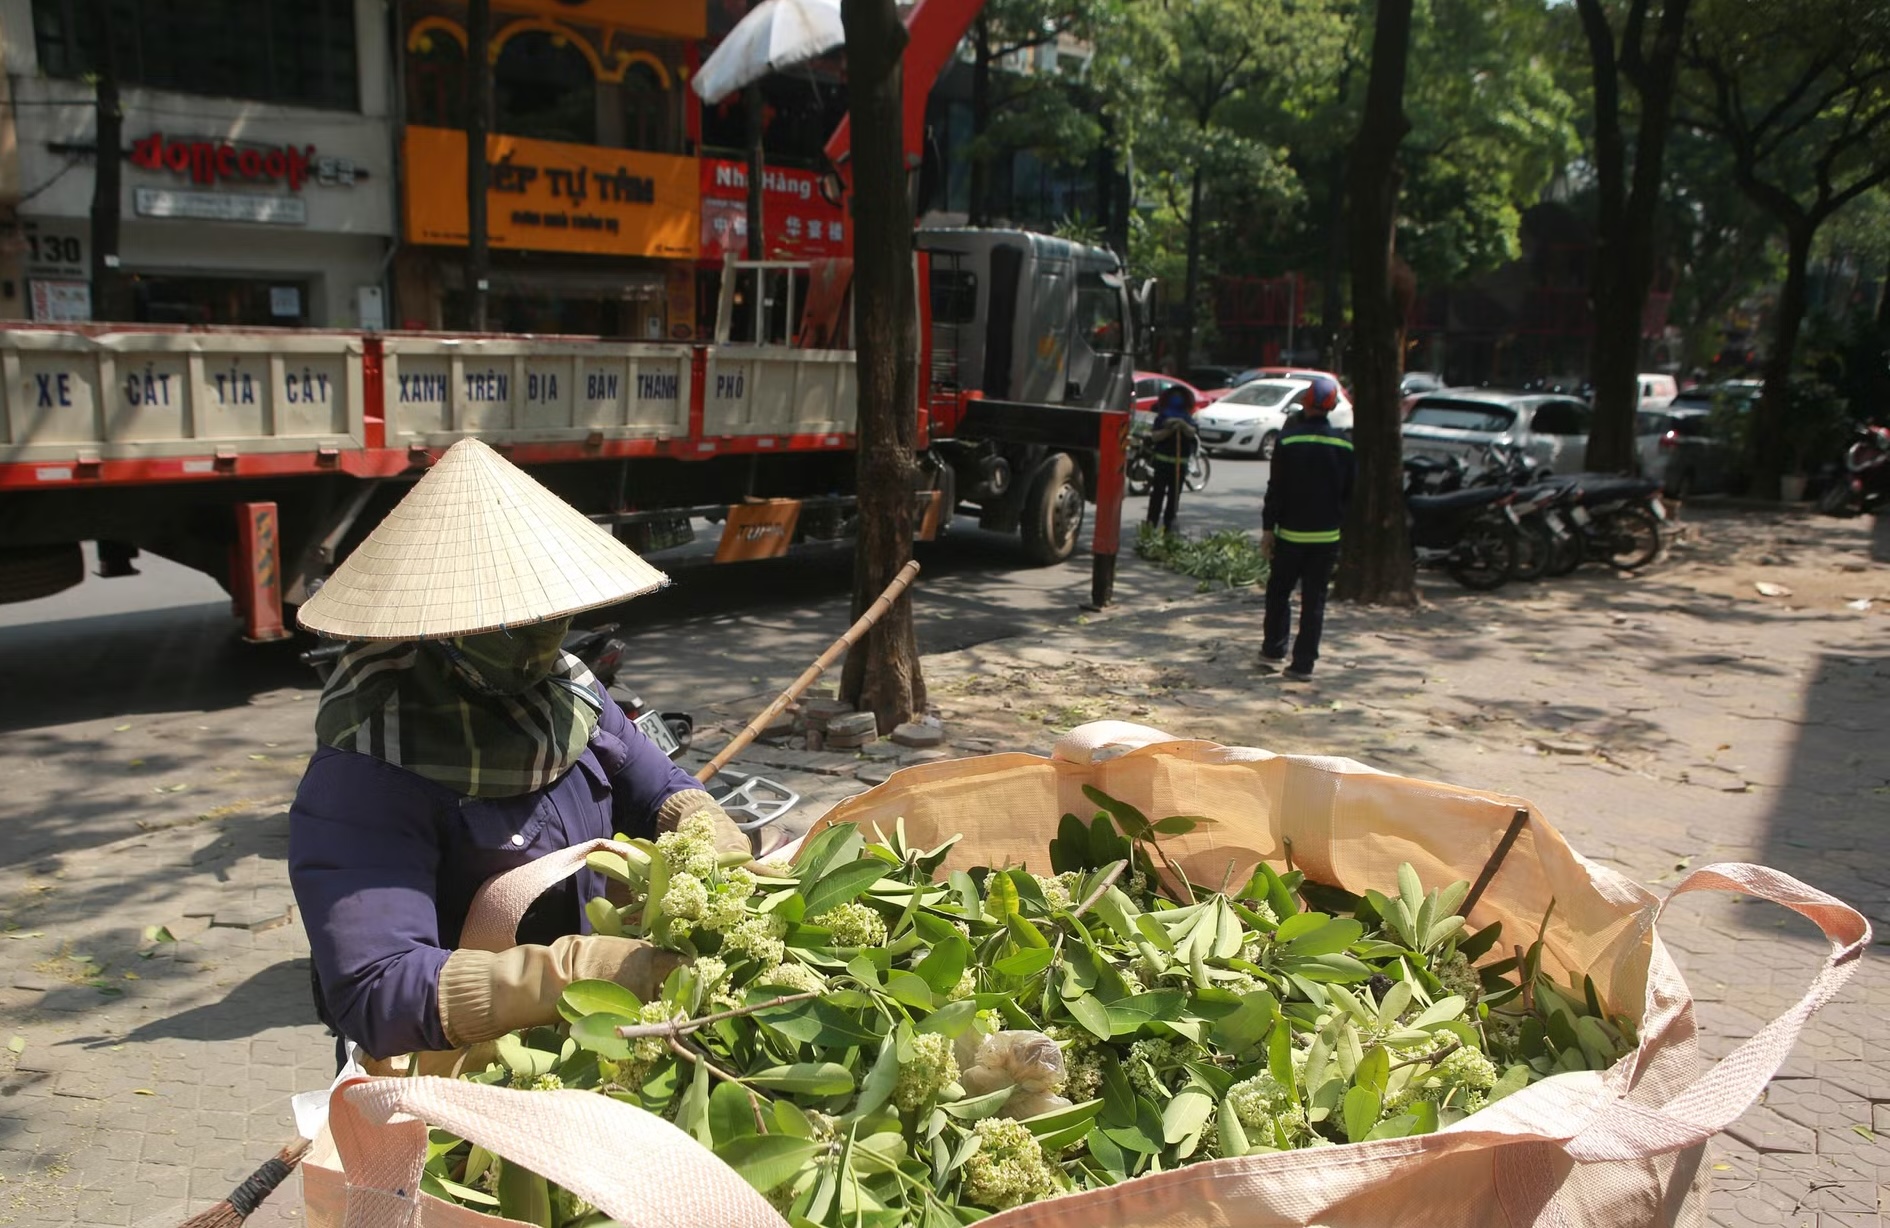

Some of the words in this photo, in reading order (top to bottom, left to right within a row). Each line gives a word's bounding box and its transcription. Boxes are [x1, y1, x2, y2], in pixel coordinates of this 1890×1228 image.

[544, 165, 587, 208] TỰ
[716, 166, 748, 187] Nh
[761, 171, 811, 199] Hàng
[27, 234, 82, 263] 130
[36, 372, 72, 408] XE
[399, 373, 447, 403] XANH
[465, 368, 508, 402] TRÊN
[528, 373, 558, 405] ĐỊA
[587, 367, 617, 400] BÀN
[637, 367, 678, 400] THÀNH
[716, 365, 744, 399] PHỐ
